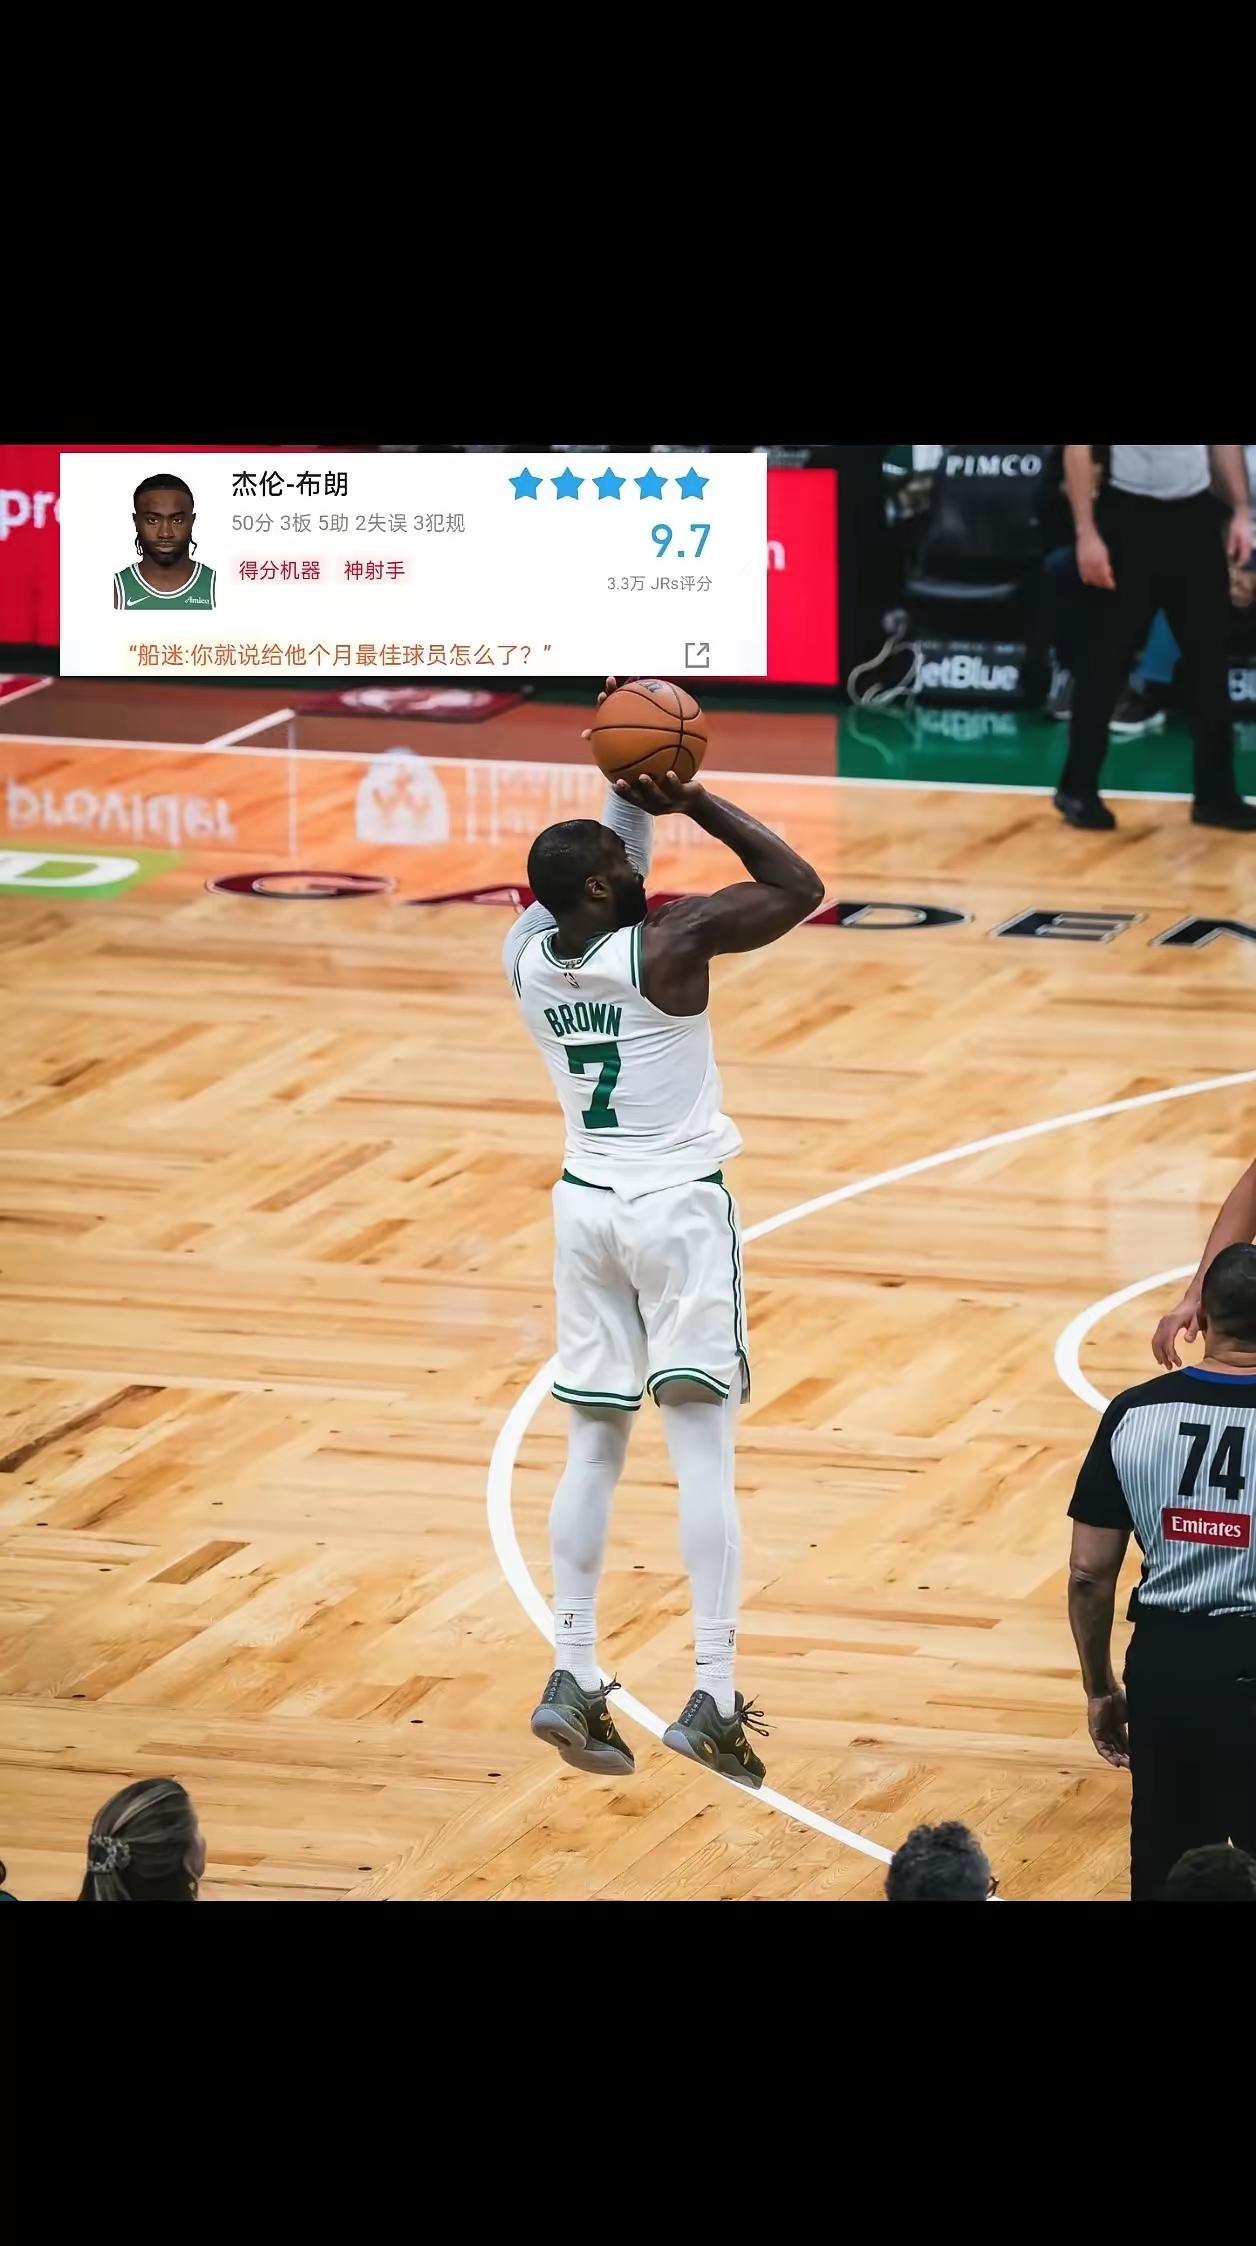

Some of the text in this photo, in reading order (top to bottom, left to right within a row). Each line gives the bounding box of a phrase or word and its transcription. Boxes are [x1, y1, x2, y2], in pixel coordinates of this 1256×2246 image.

[945, 454, 1042, 477] PIMCO
[544, 1002, 622, 1037] BROWN
[564, 1042, 621, 1129] 7
[1178, 1422, 1246, 1501] 74
[1171, 1516, 1241, 1538] Emirates
